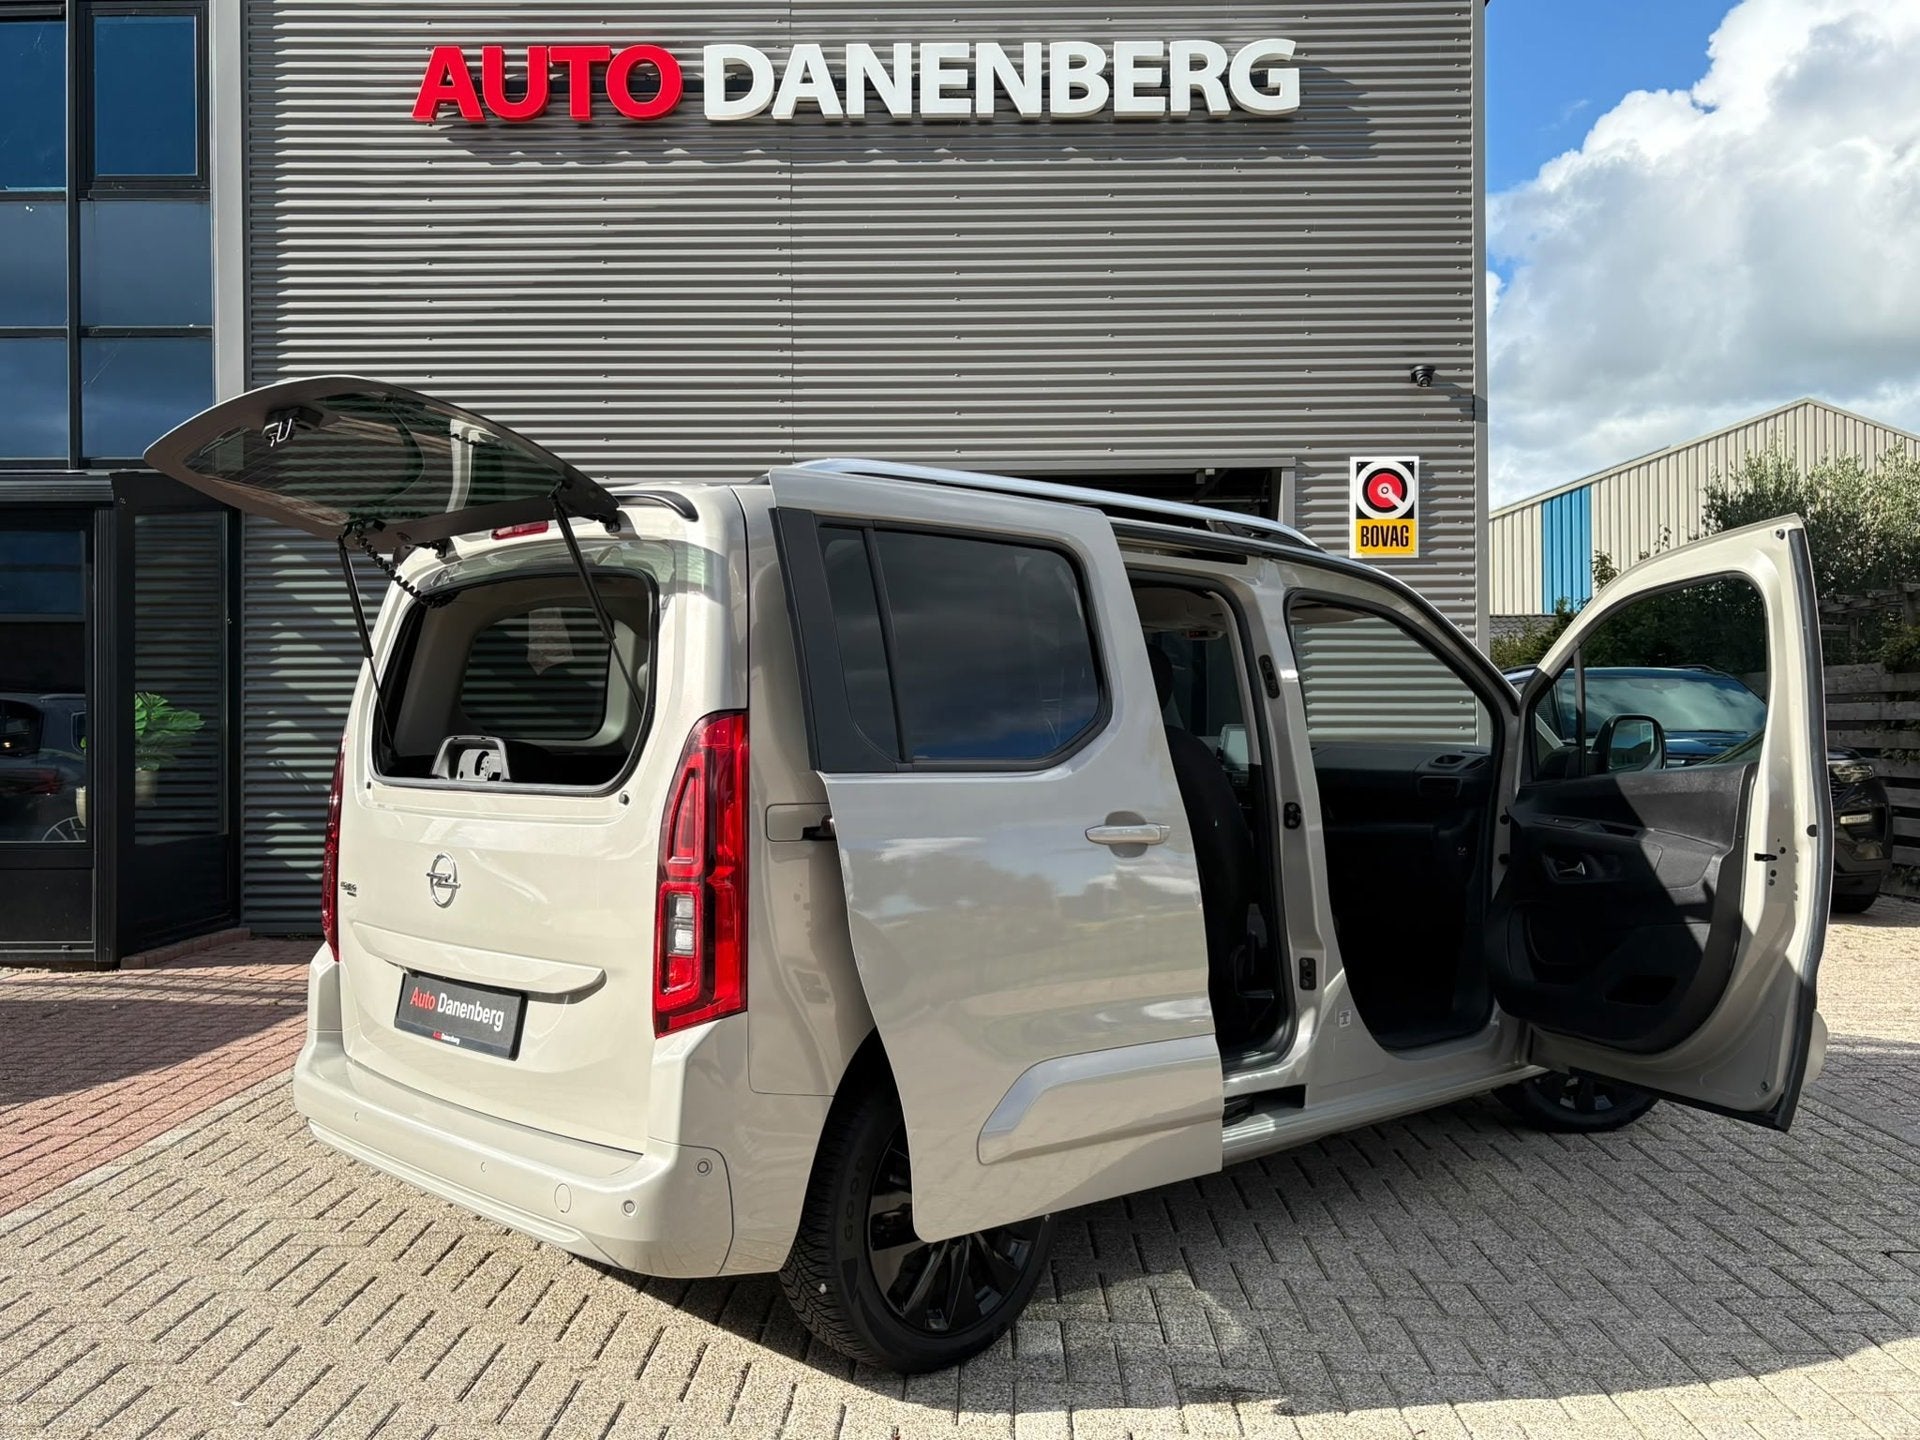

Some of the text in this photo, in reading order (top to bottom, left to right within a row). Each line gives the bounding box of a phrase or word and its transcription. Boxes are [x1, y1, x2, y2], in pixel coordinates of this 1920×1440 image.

[411, 39, 1300, 122] AUTO DANENBERG
[1360, 525, 1409, 547] BOVAG
[410, 987, 505, 1032] Auto Danenberg
